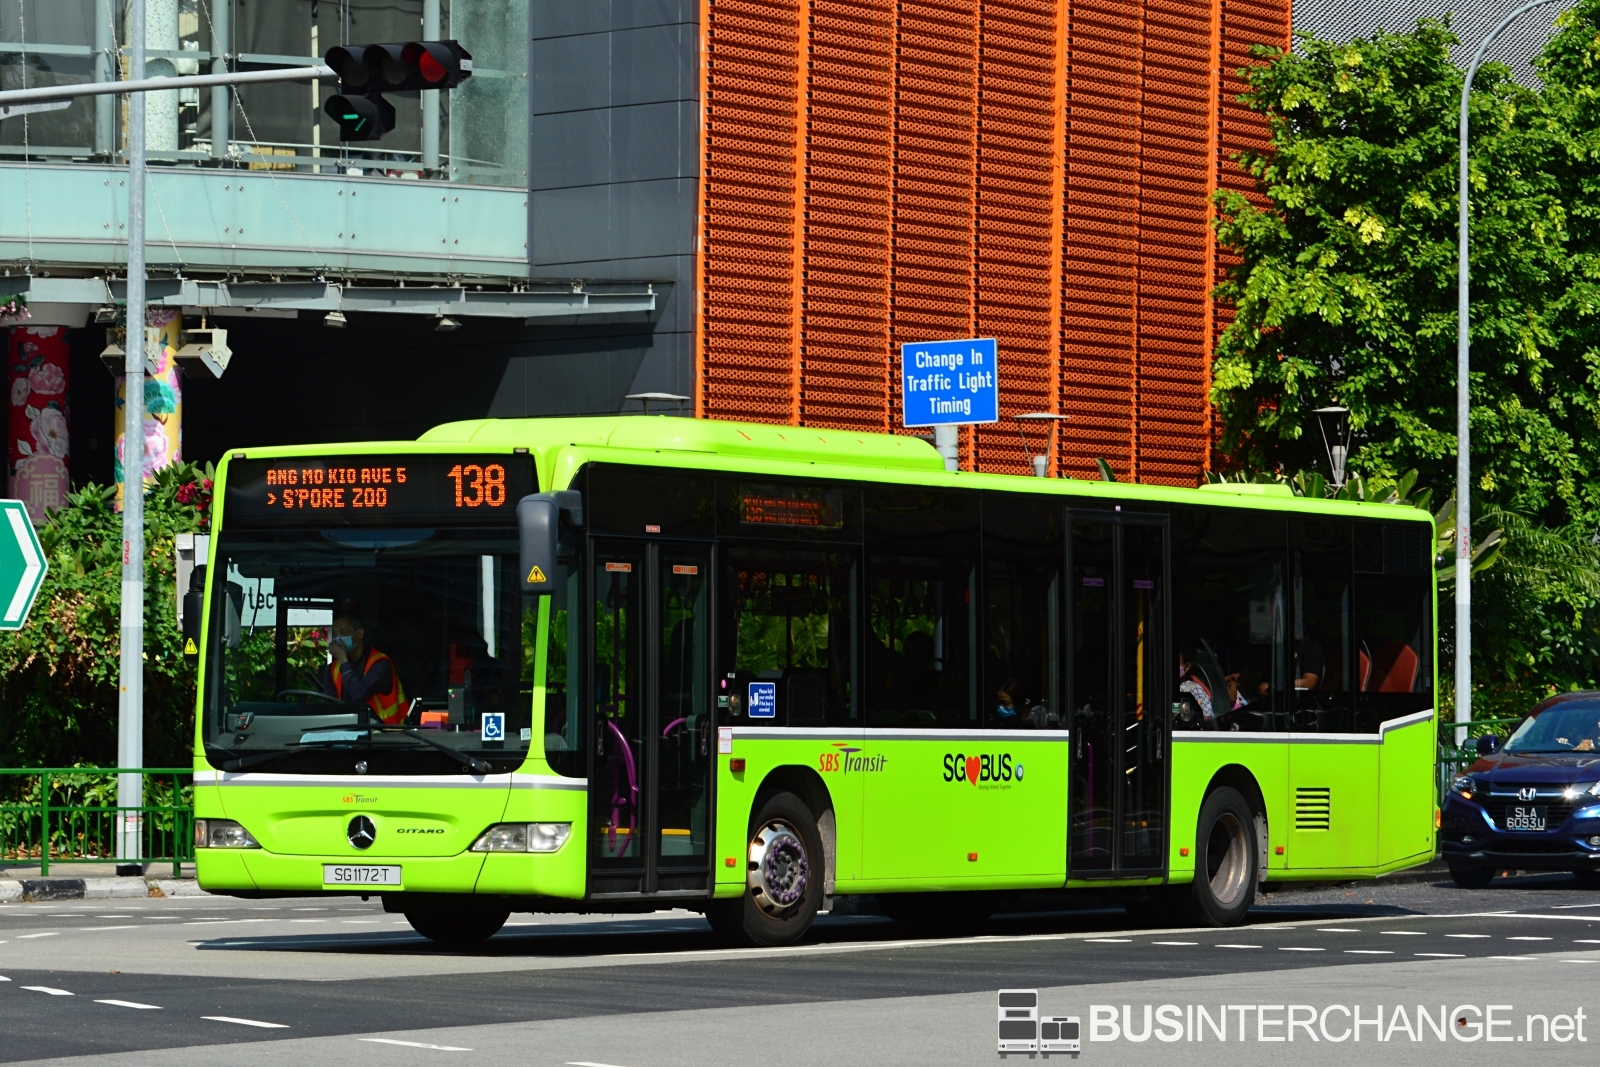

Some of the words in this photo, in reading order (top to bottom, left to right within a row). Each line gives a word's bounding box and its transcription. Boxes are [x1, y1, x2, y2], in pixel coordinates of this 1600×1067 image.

[915, 351, 964, 371] Change
[971, 348, 983, 365] In
[907, 373, 952, 392] Traffic
[959, 371, 993, 393] Light
[929, 396, 971, 416] Timing
[267, 469, 298, 485] ANG
[302, 469, 324, 484] MO
[328, 468, 356, 484] KIO
[361, 468, 392, 484] AVE
[396, 468, 407, 483] 5
[447, 464, 506, 507] 138
[29, 473, 59, 507] 福
[282, 488, 345, 508] S'PORE
[352, 487, 388, 507] ZOO
[819, 753, 840, 772] SBS
[838, 748, 888, 776] Transit
[342, 796, 354, 804] SBS
[354, 794, 378, 804] Transit
[1515, 807, 1537, 818] SLA
[1506, 818, 1546, 828] 6093U
[334, 868, 389, 882] SG1172T
